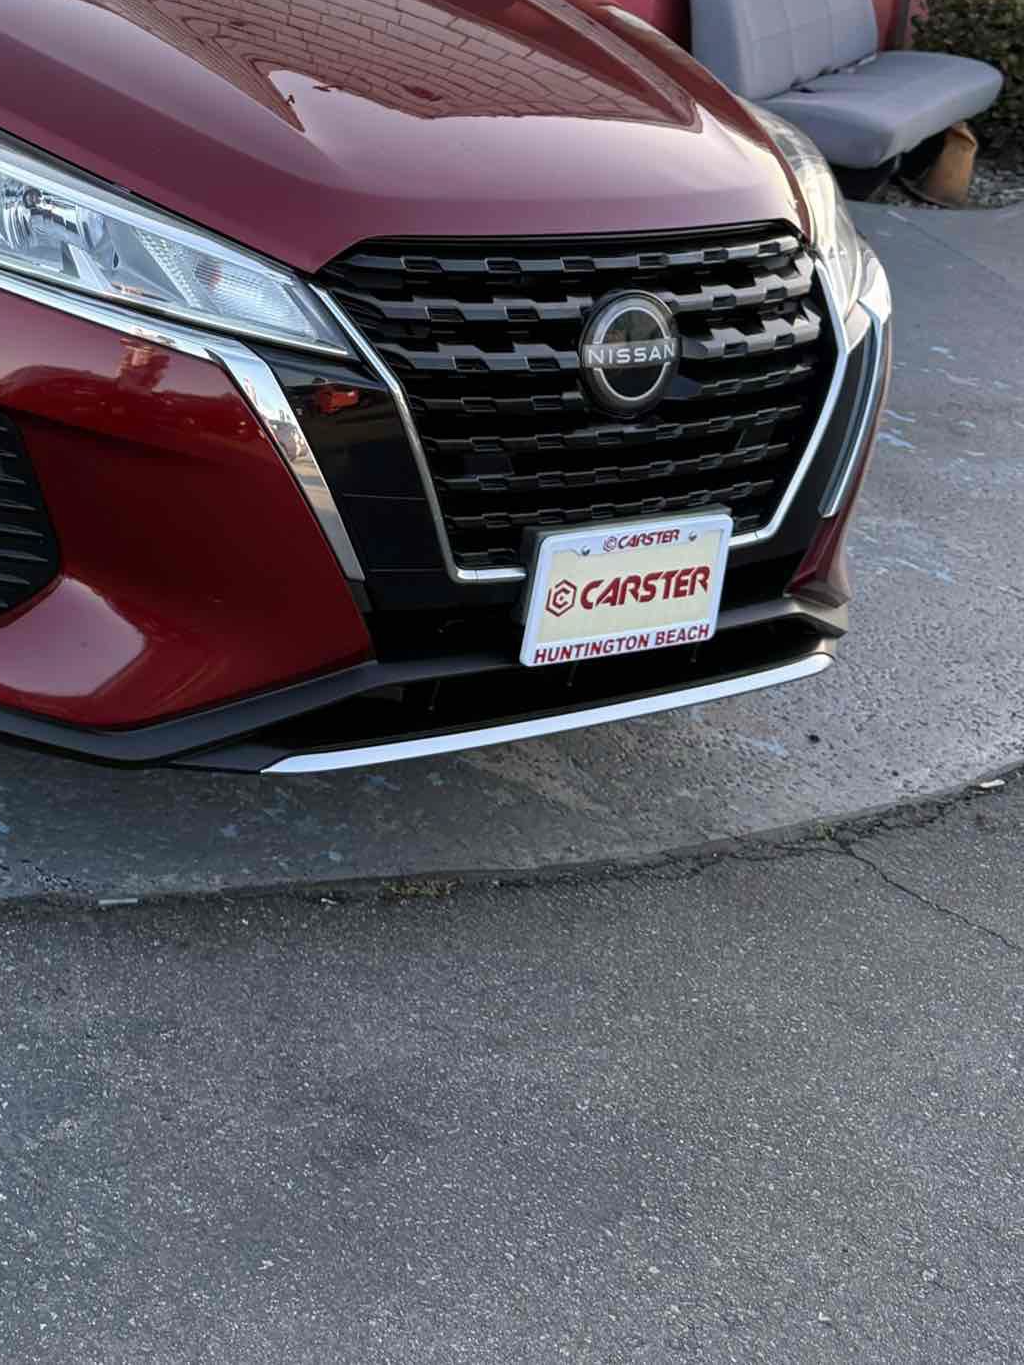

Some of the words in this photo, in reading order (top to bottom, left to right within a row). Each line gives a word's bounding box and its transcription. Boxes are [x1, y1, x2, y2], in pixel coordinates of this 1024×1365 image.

[588, 343, 675, 365] NISSAN
[618, 528, 681, 550] CARSTER
[579, 565, 712, 610] CARSTER
[533, 633, 651, 665] HUNTINGTON
[654, 624, 711, 647] BEACH
